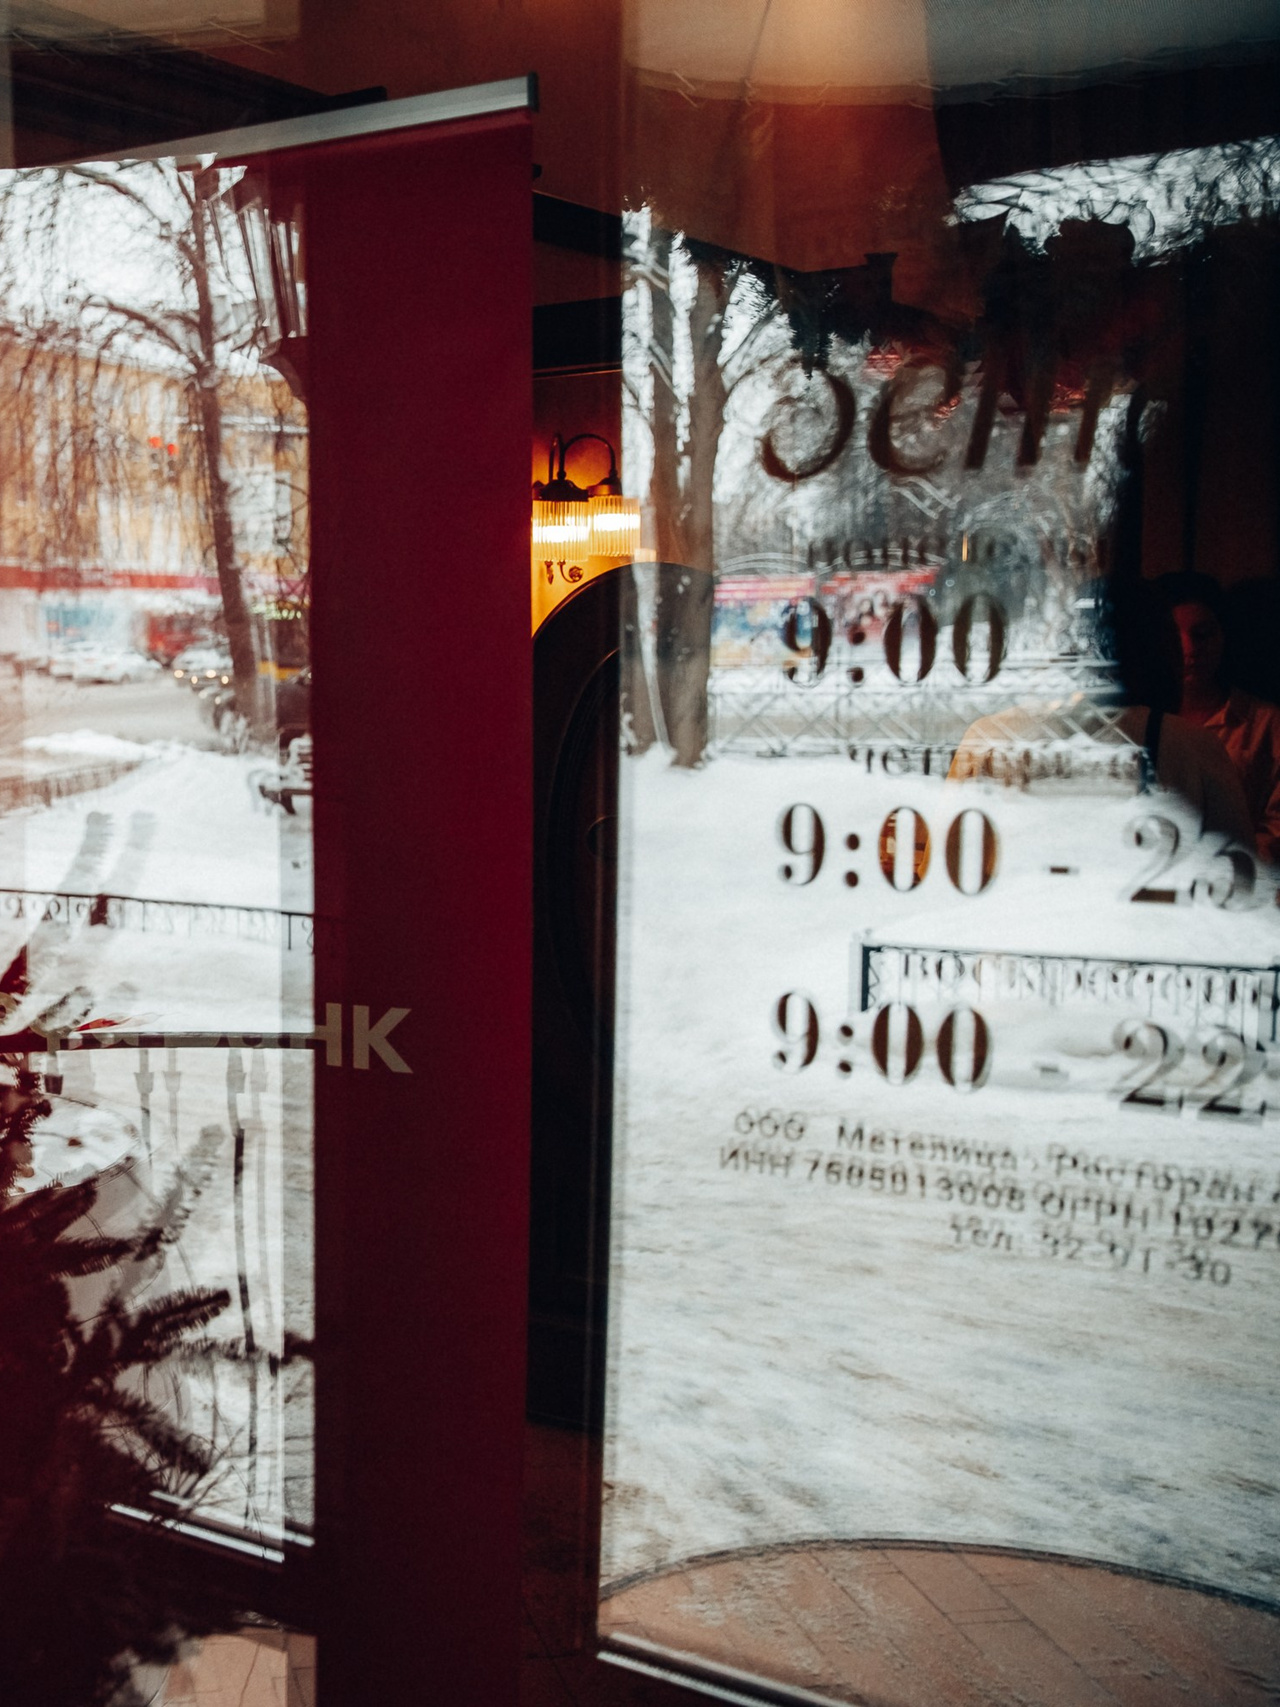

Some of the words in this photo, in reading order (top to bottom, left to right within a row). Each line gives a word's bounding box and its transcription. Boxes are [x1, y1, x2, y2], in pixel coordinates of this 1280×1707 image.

[781, 594, 1007, 688] 9:00
[776, 803, 1000, 897] 9:00
[773, 991, 994, 1094] 9:00
[733, 1104, 808, 1142] ООО
[718, 1139, 795, 1180] ИНН
[1168, 1204, 1280, 1252] 1027
